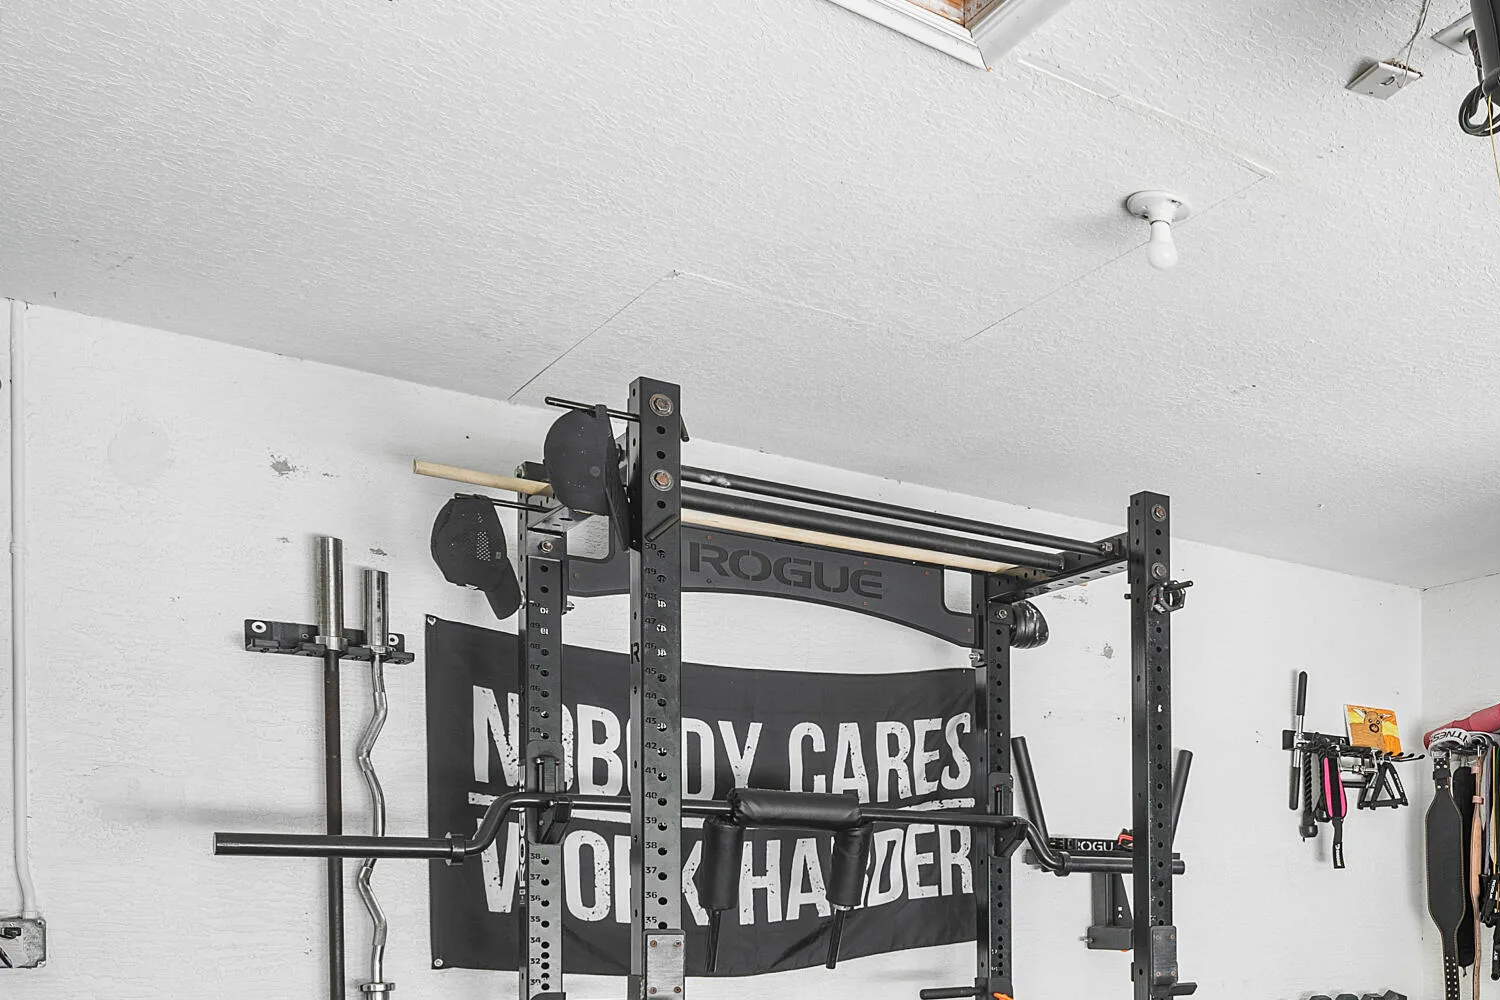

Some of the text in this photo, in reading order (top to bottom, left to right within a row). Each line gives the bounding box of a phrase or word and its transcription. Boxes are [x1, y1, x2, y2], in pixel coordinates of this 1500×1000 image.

[644, 542, 657, 550] 50
[689, 541, 882, 600] ROGUE
[473, 685, 762, 800] NBDY
[788, 712, 971, 804] CARES
[644, 742, 657, 750] 42
[644, 791, 657, 799] 40
[644, 816, 657, 824] 39
[644, 841, 657, 849] 38
[644, 866, 657, 874] 37
[739, 823, 974, 926] HADER
[644, 891, 657, 899] 36
[644, 916, 657, 924] 35
